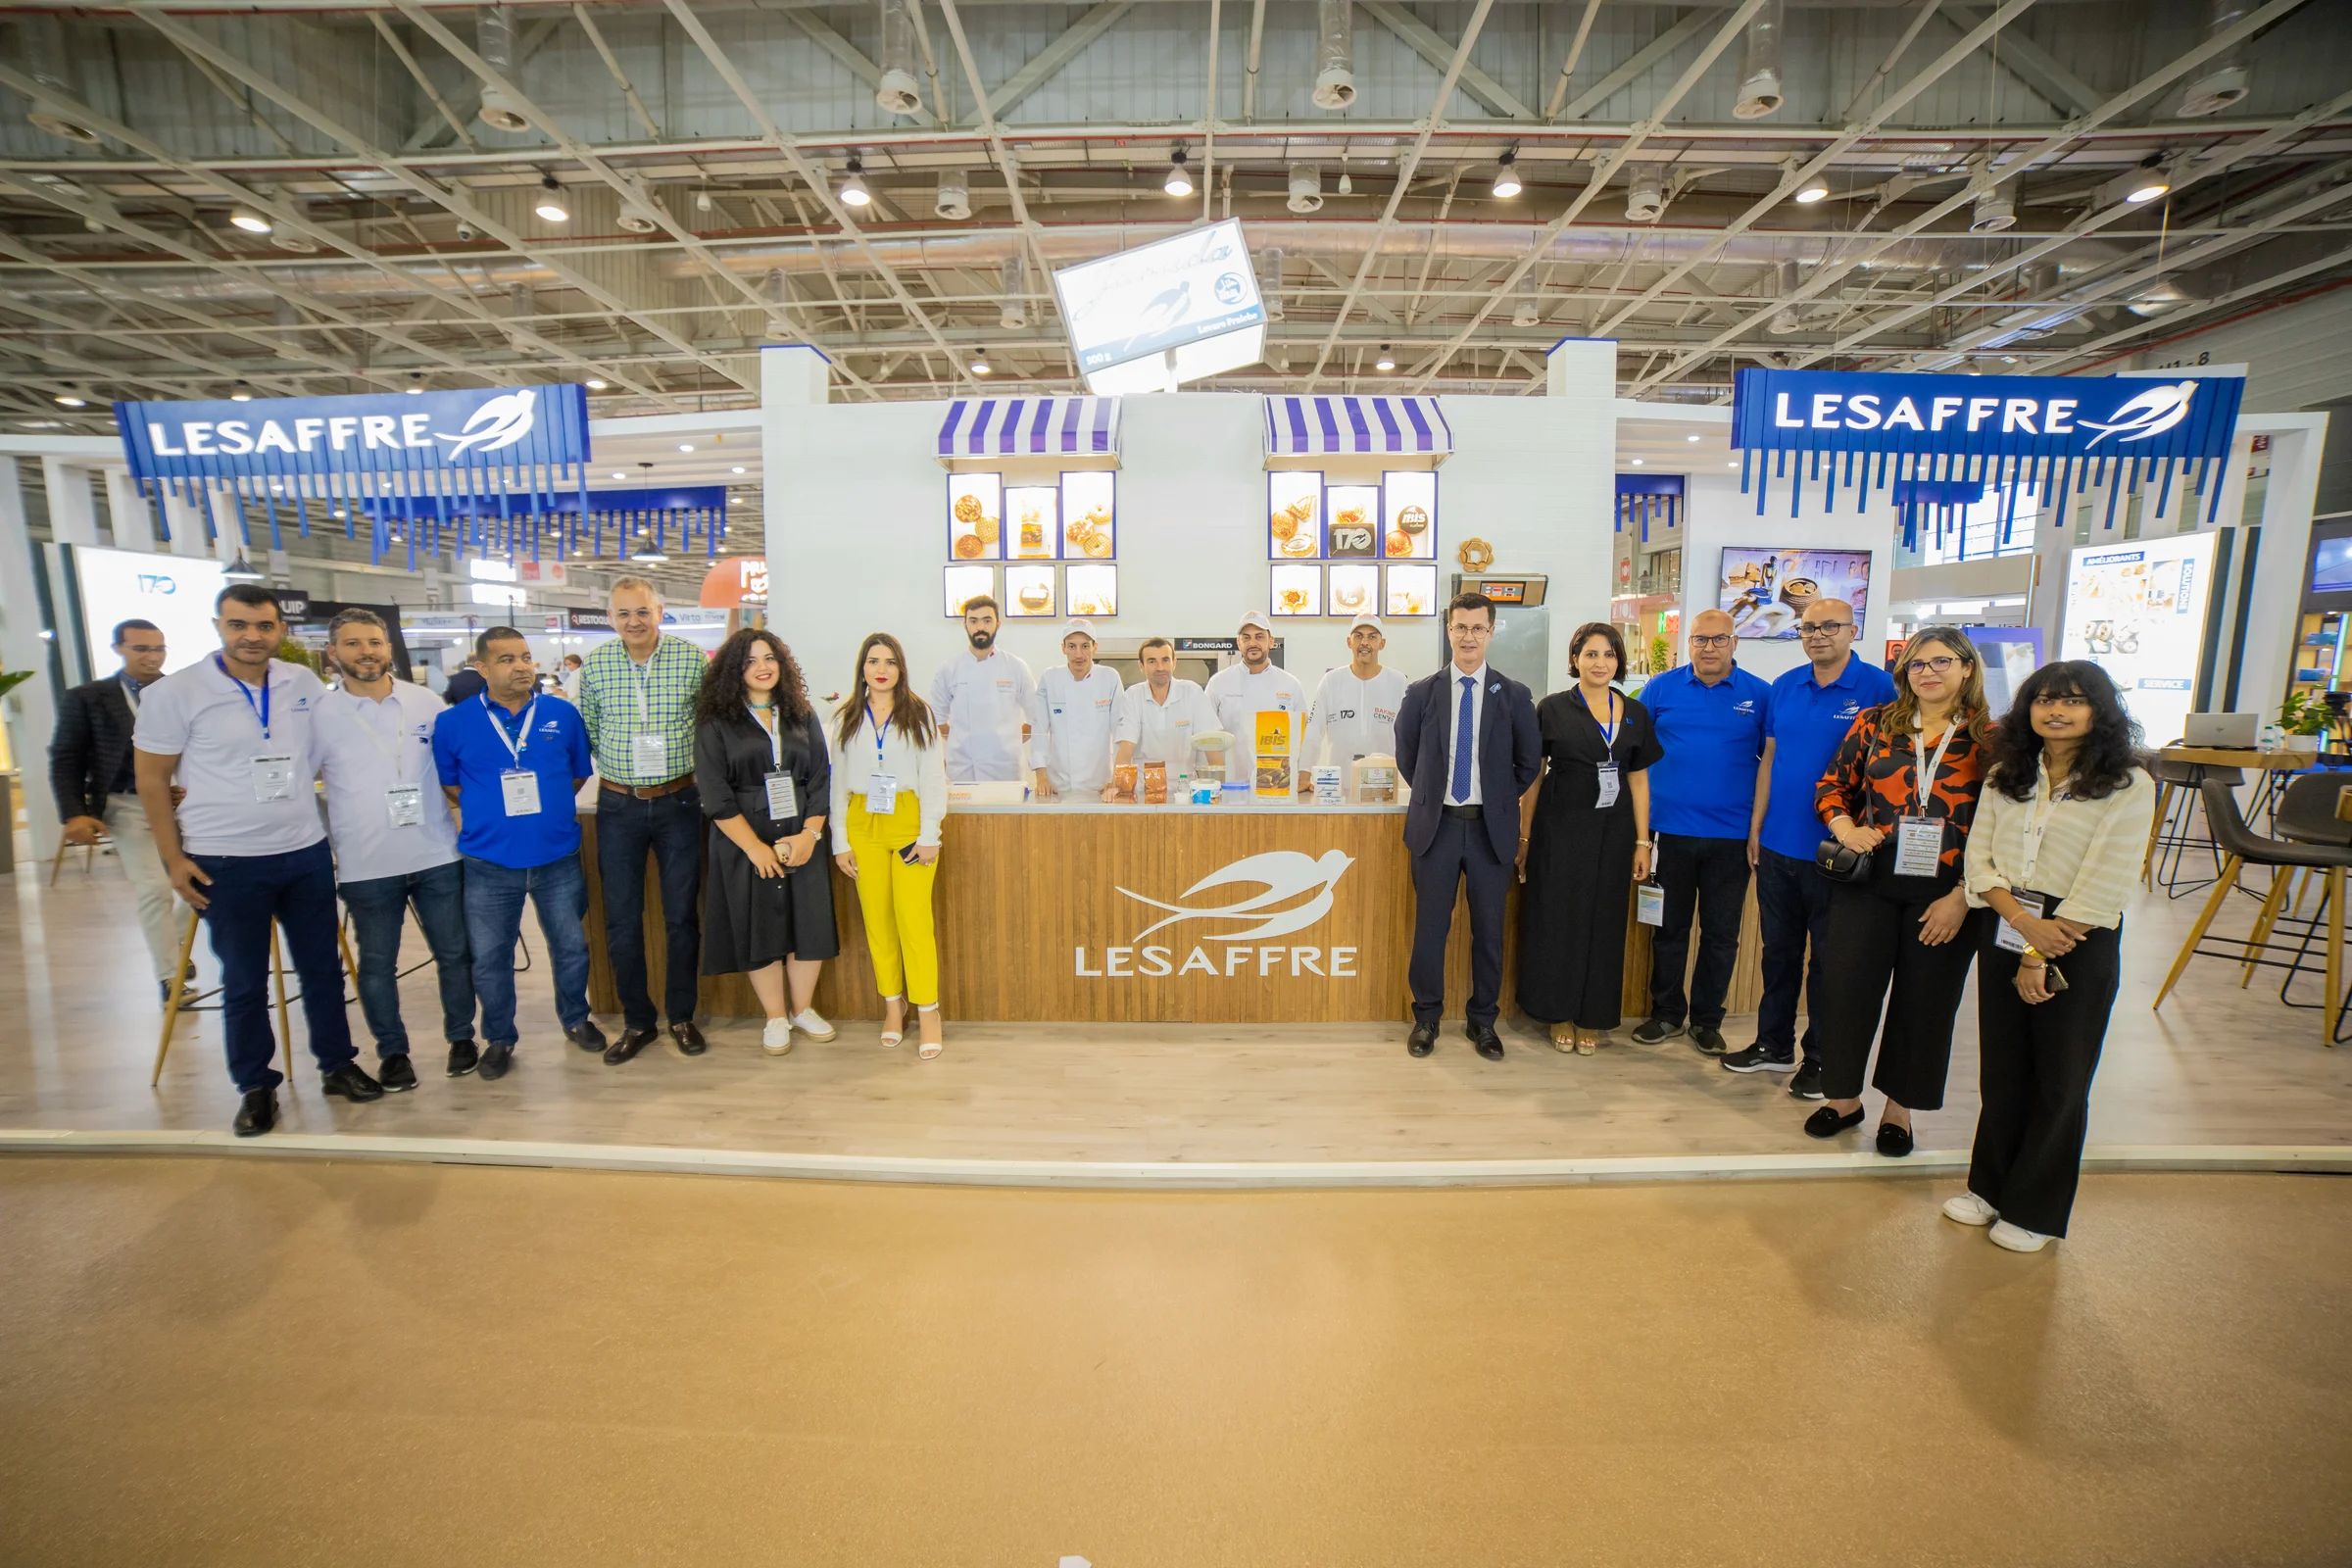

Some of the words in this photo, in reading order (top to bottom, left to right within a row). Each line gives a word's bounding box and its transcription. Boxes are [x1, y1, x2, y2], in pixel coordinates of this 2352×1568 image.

[1775, 392, 2078, 434] LESAFFRE
[148, 414, 432, 457] LESAFFRE
[279, 600, 304, 614] UIP
[2143, 679, 2184, 689] SERVICE
[1374, 707, 1396, 717] BAKING
[1259, 735, 1287, 746] IBIS
[1075, 945, 1357, 977] LESAFFRE
